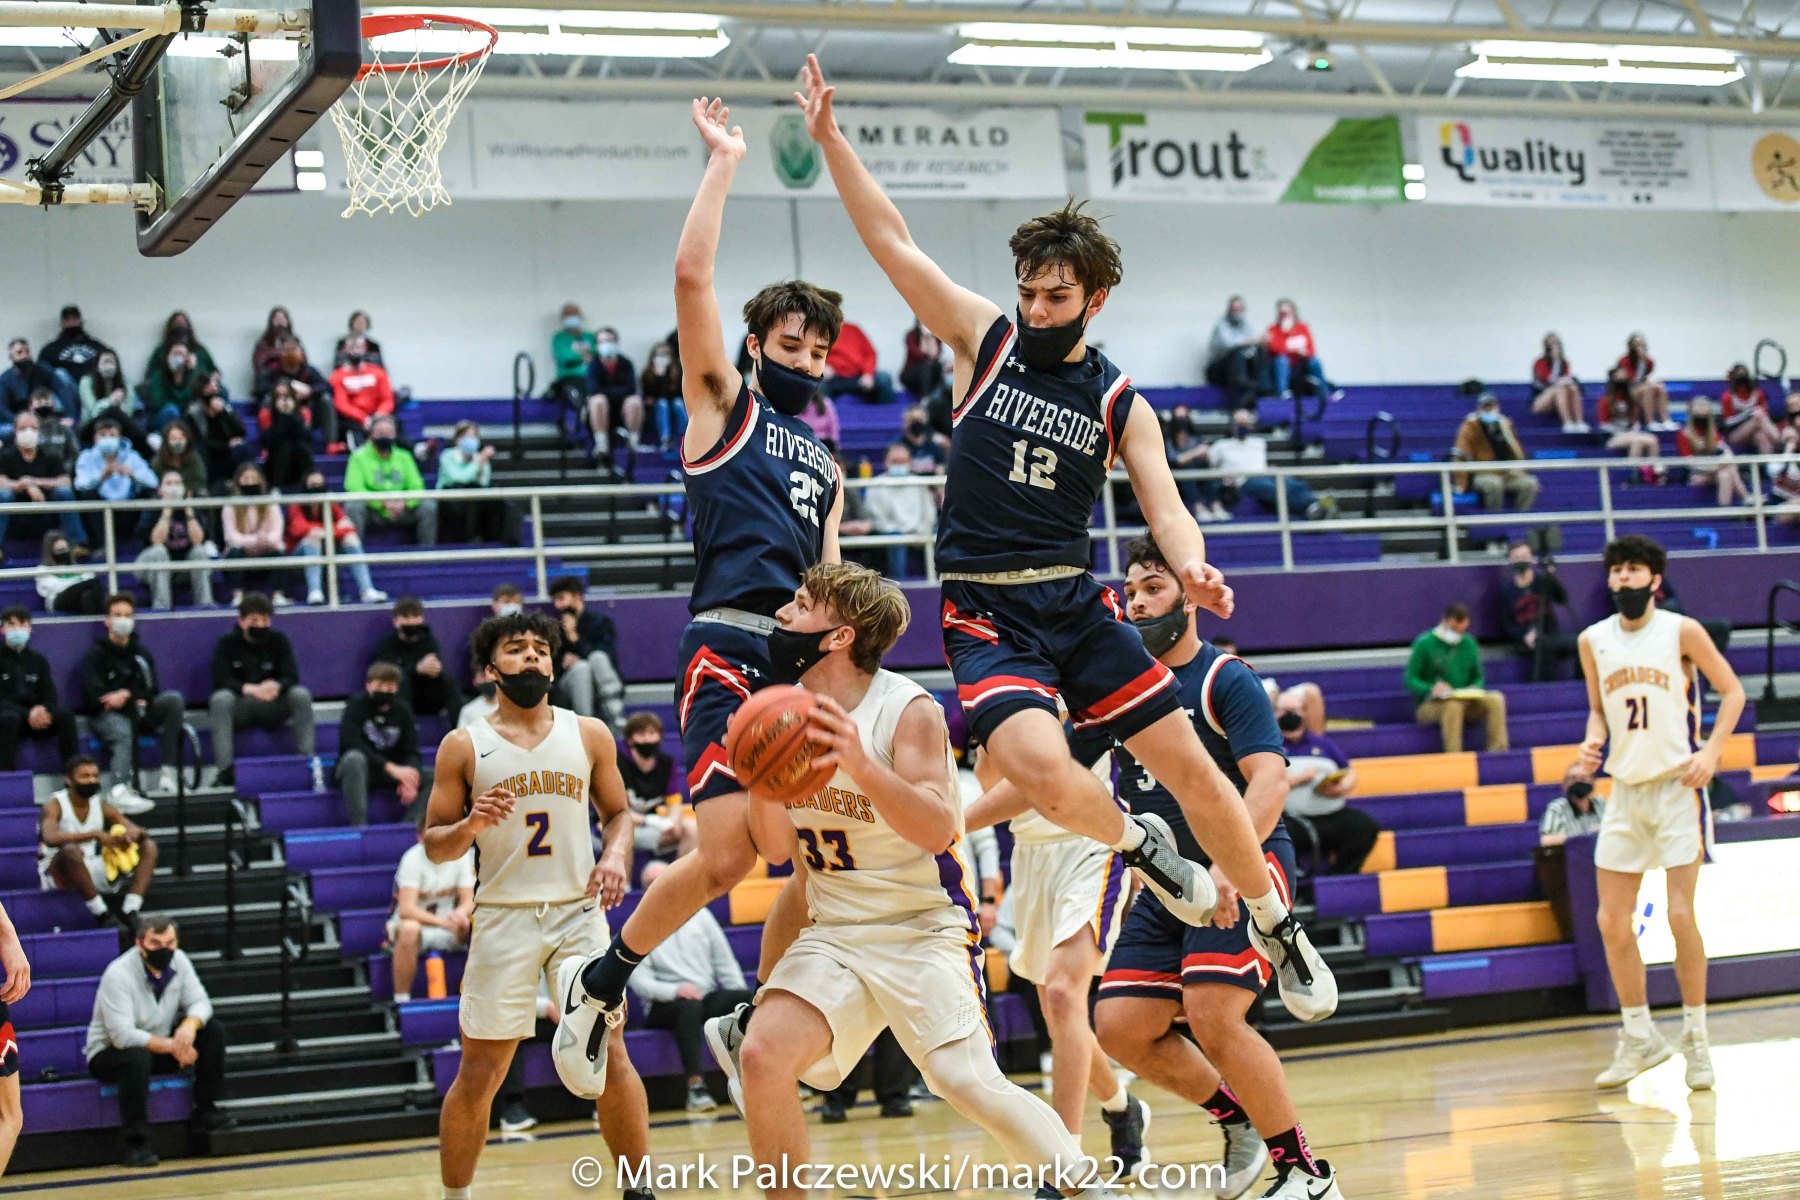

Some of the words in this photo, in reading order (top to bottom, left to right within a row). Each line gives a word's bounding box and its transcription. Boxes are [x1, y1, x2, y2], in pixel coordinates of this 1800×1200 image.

[1083, 111, 1249, 188] Trout
[1440, 122, 1586, 186] Quality
[985, 383, 1105, 457] RIVERSIDE
[1008, 439, 1058, 490] 12
[789, 471, 824, 527] 25
[1625, 696, 1648, 731] 21
[491, 771, 583, 804] USADERS
[784, 786, 876, 823] ADERS
[524, 811, 553, 858] 2
[796, 827, 857, 872] 33
